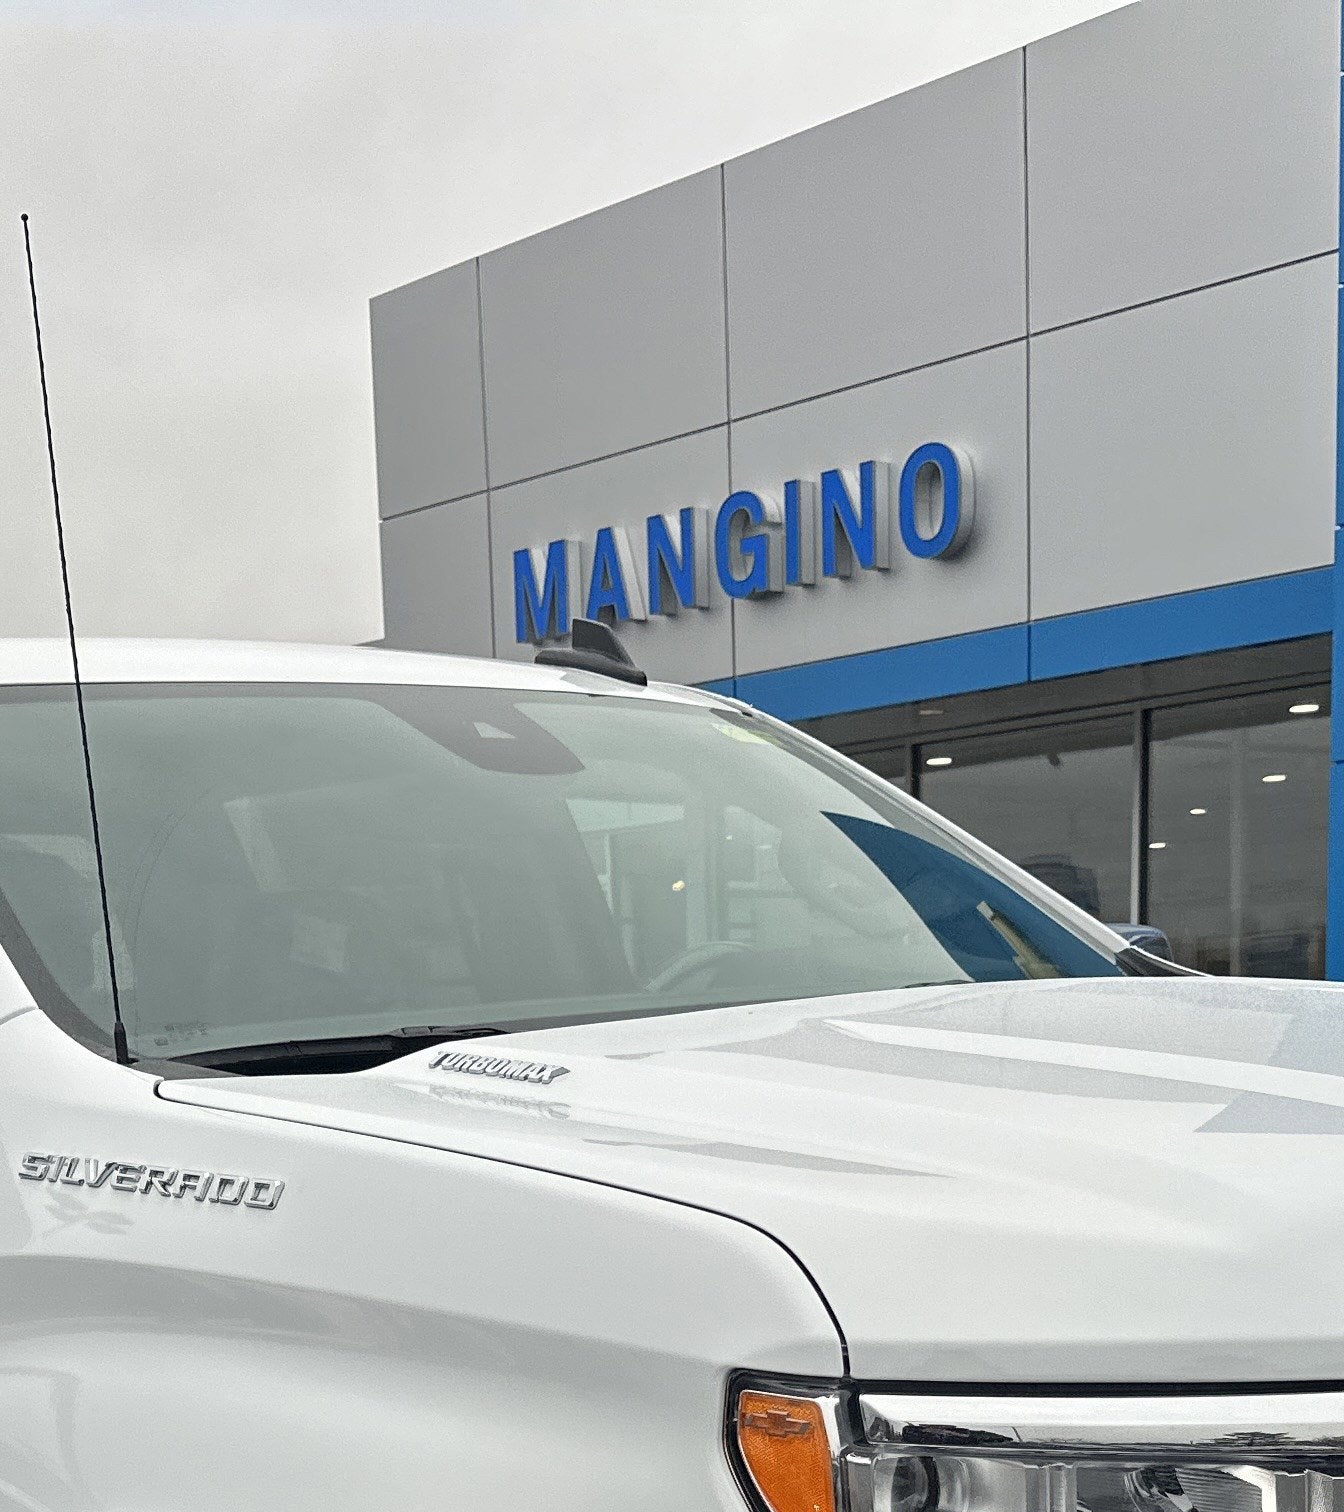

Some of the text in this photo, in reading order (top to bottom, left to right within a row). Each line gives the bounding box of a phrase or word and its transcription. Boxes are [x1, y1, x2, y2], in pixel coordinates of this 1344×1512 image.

[513, 441, 974, 644] MANGINO
[429, 1050, 566, 1084] TURBOMAX
[19, 1151, 285, 1210] SILVERADO
